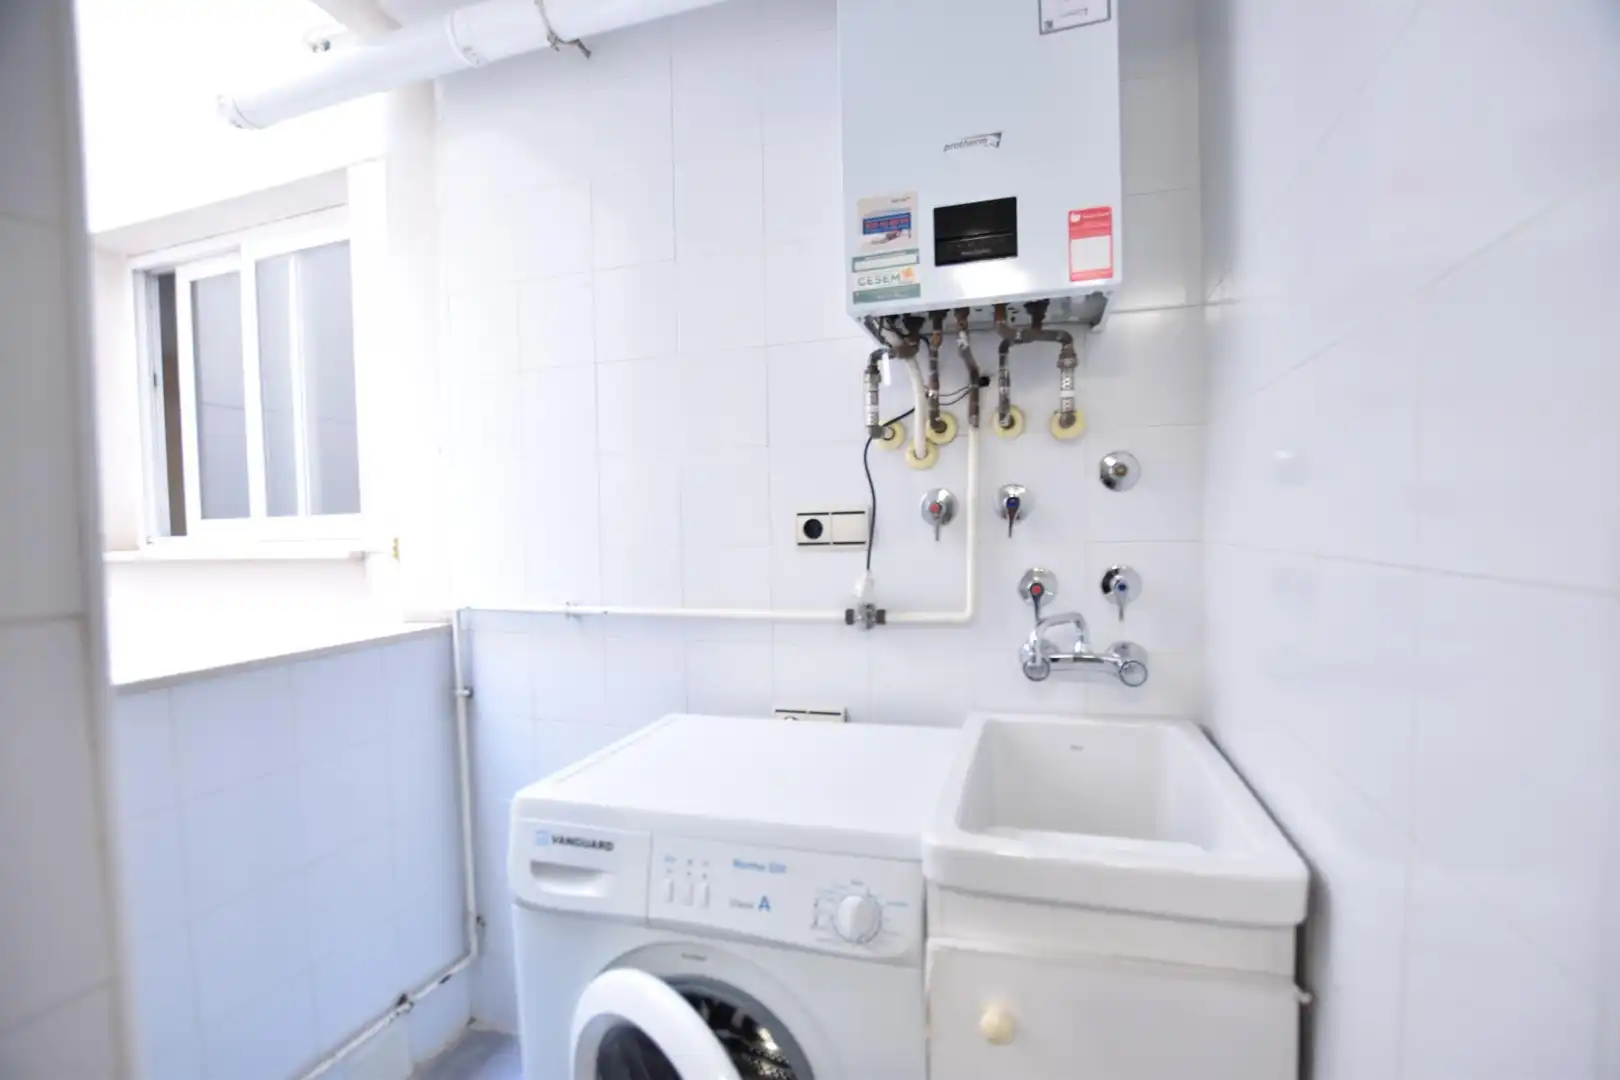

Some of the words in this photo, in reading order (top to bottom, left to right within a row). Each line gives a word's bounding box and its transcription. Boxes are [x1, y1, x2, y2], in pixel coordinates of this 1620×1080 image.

[858, 273, 901, 286] CESEM
[551, 835, 615, 852] VANGUARD
[758, 895, 771, 912] A
